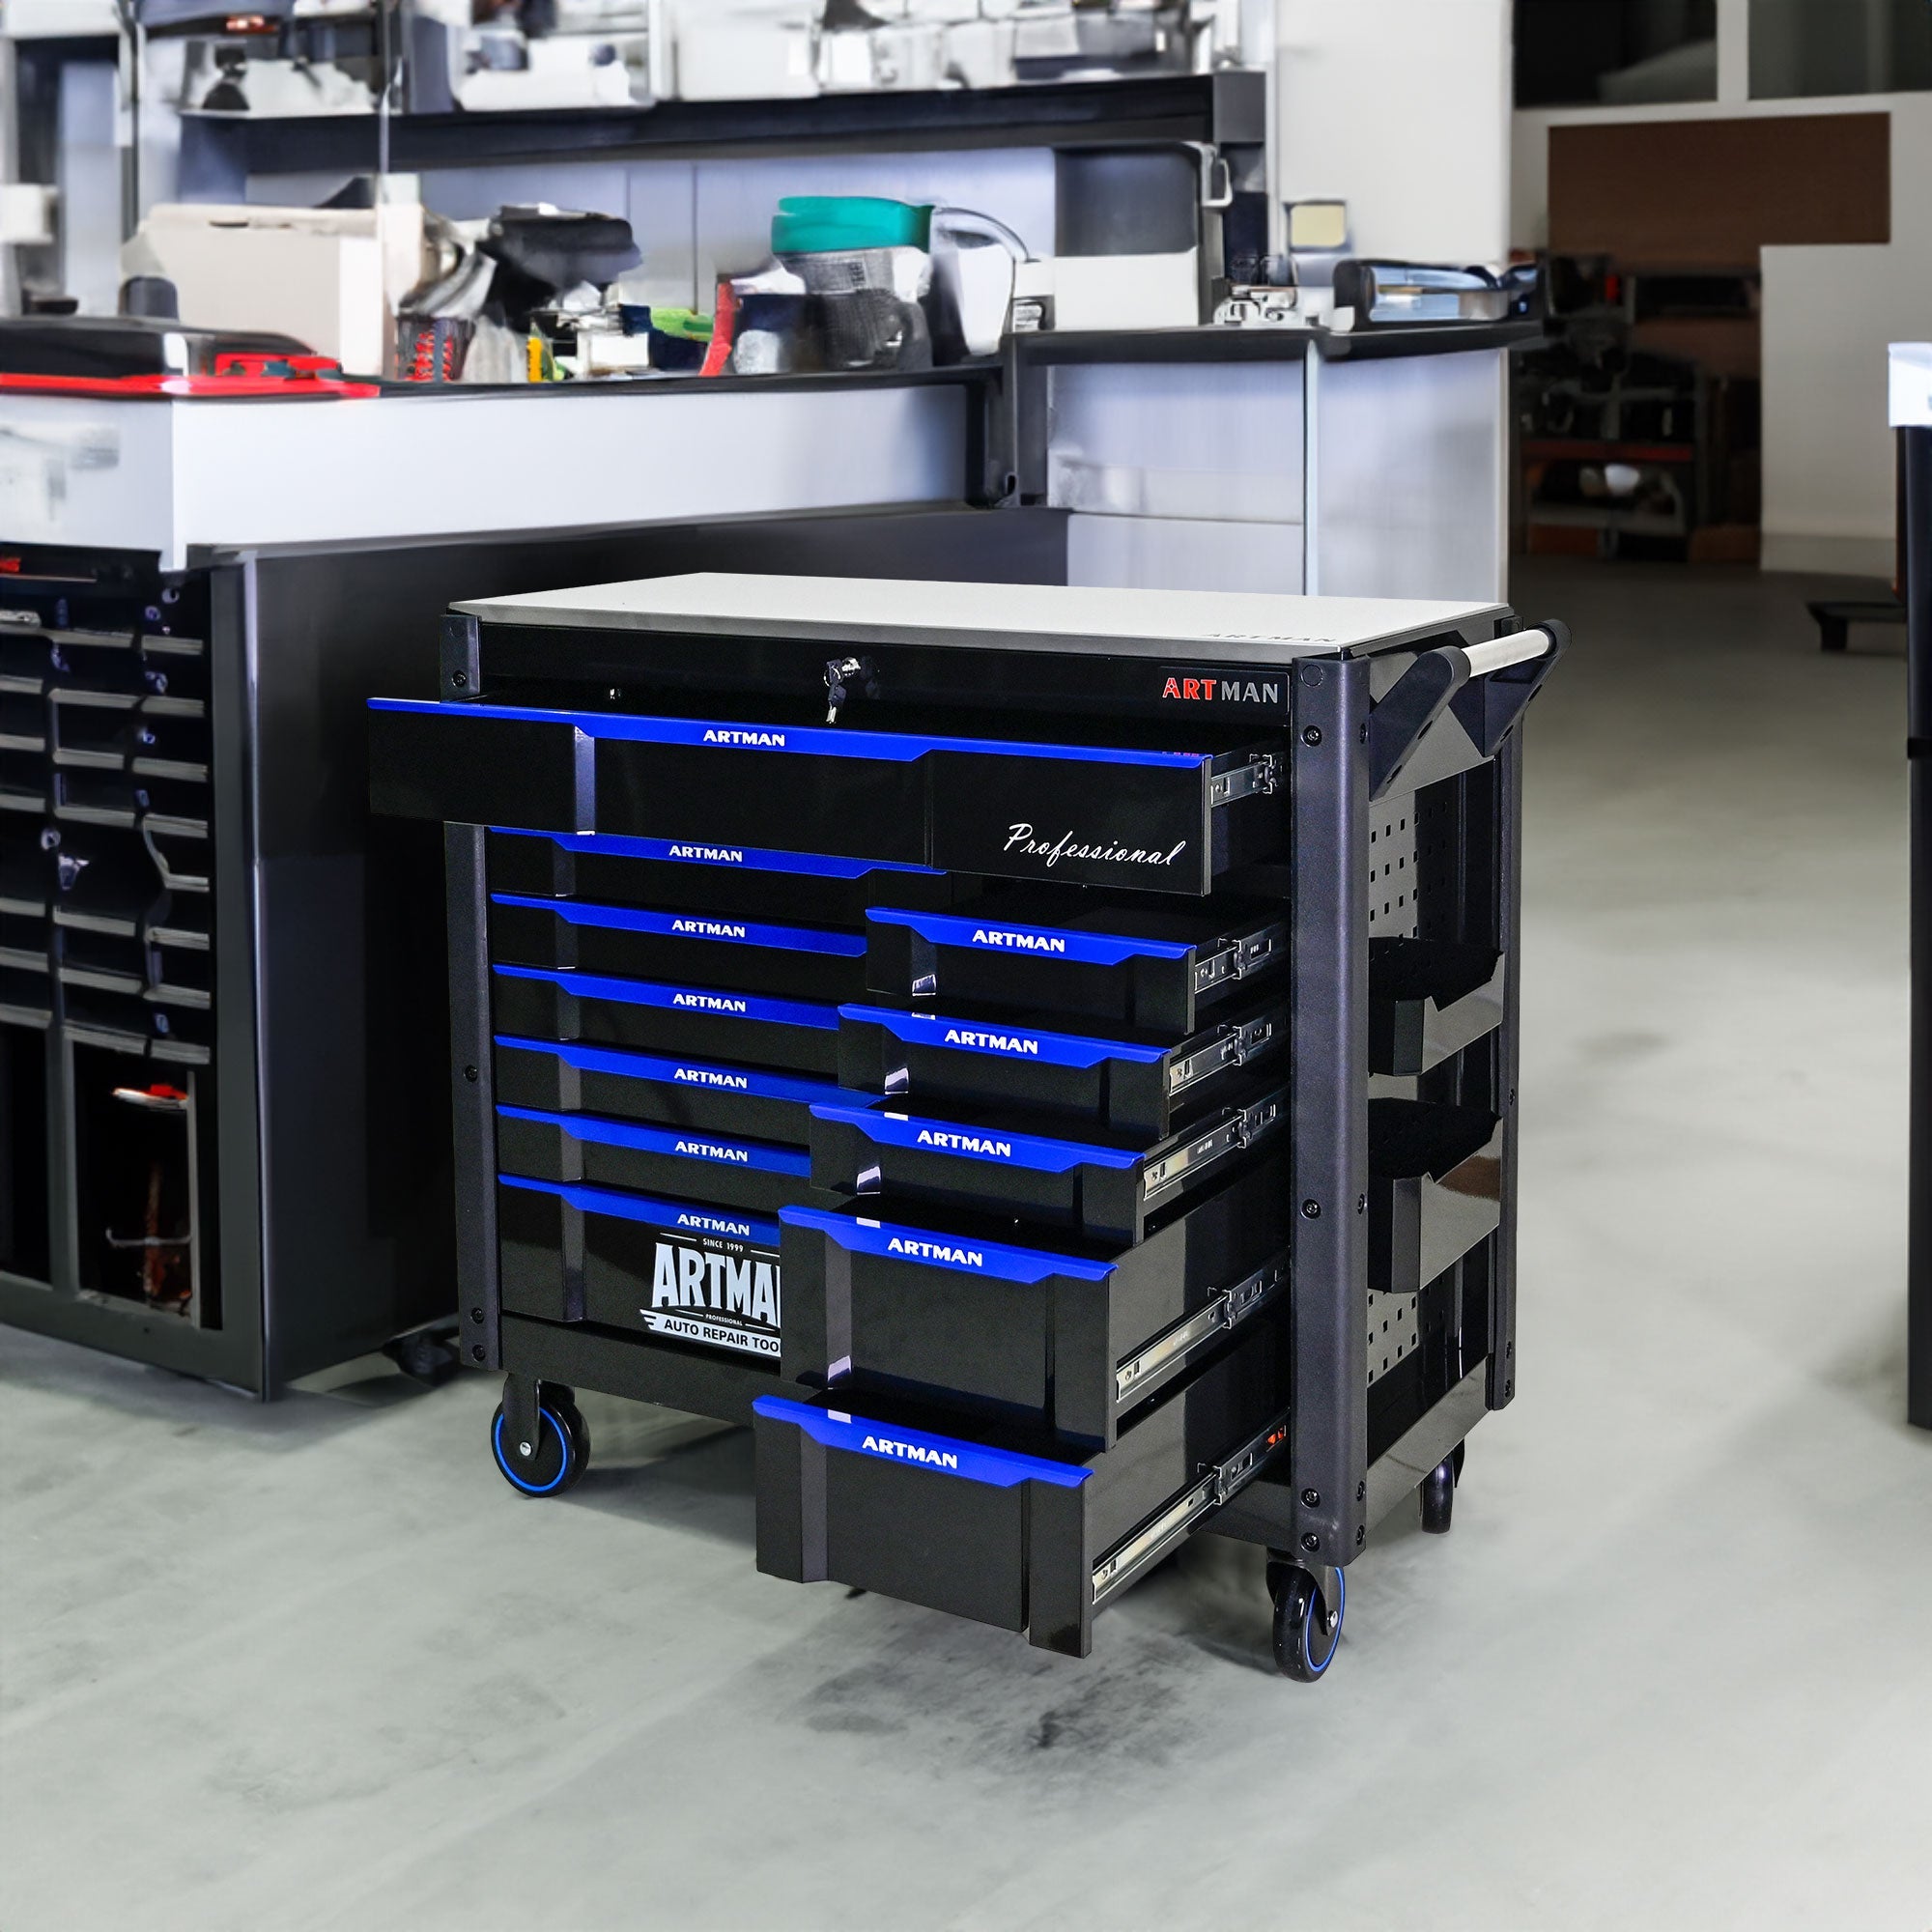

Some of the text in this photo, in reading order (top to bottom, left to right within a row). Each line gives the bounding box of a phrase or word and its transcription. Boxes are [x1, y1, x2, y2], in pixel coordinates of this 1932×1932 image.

[1162, 676, 1279, 704] ARTMAN
[702, 729, 785, 747] ARTMAN
[668, 844, 743, 863] ARTMAN
[1003, 822, 1186, 867] Professional
[671, 919, 746, 938] ARTMAN
[972, 929, 1065, 953] ARTMAN
[672, 993, 746, 1012] ARTMAN
[944, 1029, 1038, 1055] ARTMAN
[673, 1067, 748, 1089] ARTMAN
[674, 1141, 748, 1162] ARTMAN
[917, 1129, 1011, 1157] ARTMAN
[676, 1213, 750, 1236] ARTMAN
[702, 1237, 744, 1253] SINCE 1999
[887, 1237, 983, 1267] ARTMAN
[651, 1242, 781, 1329] ARTMA
[705, 1313, 743, 1326] PROFESSIONAL
[664, 1319, 780, 1352] AUTO REPAIR TOO
[862, 1435, 958, 1469] ARTMAN
